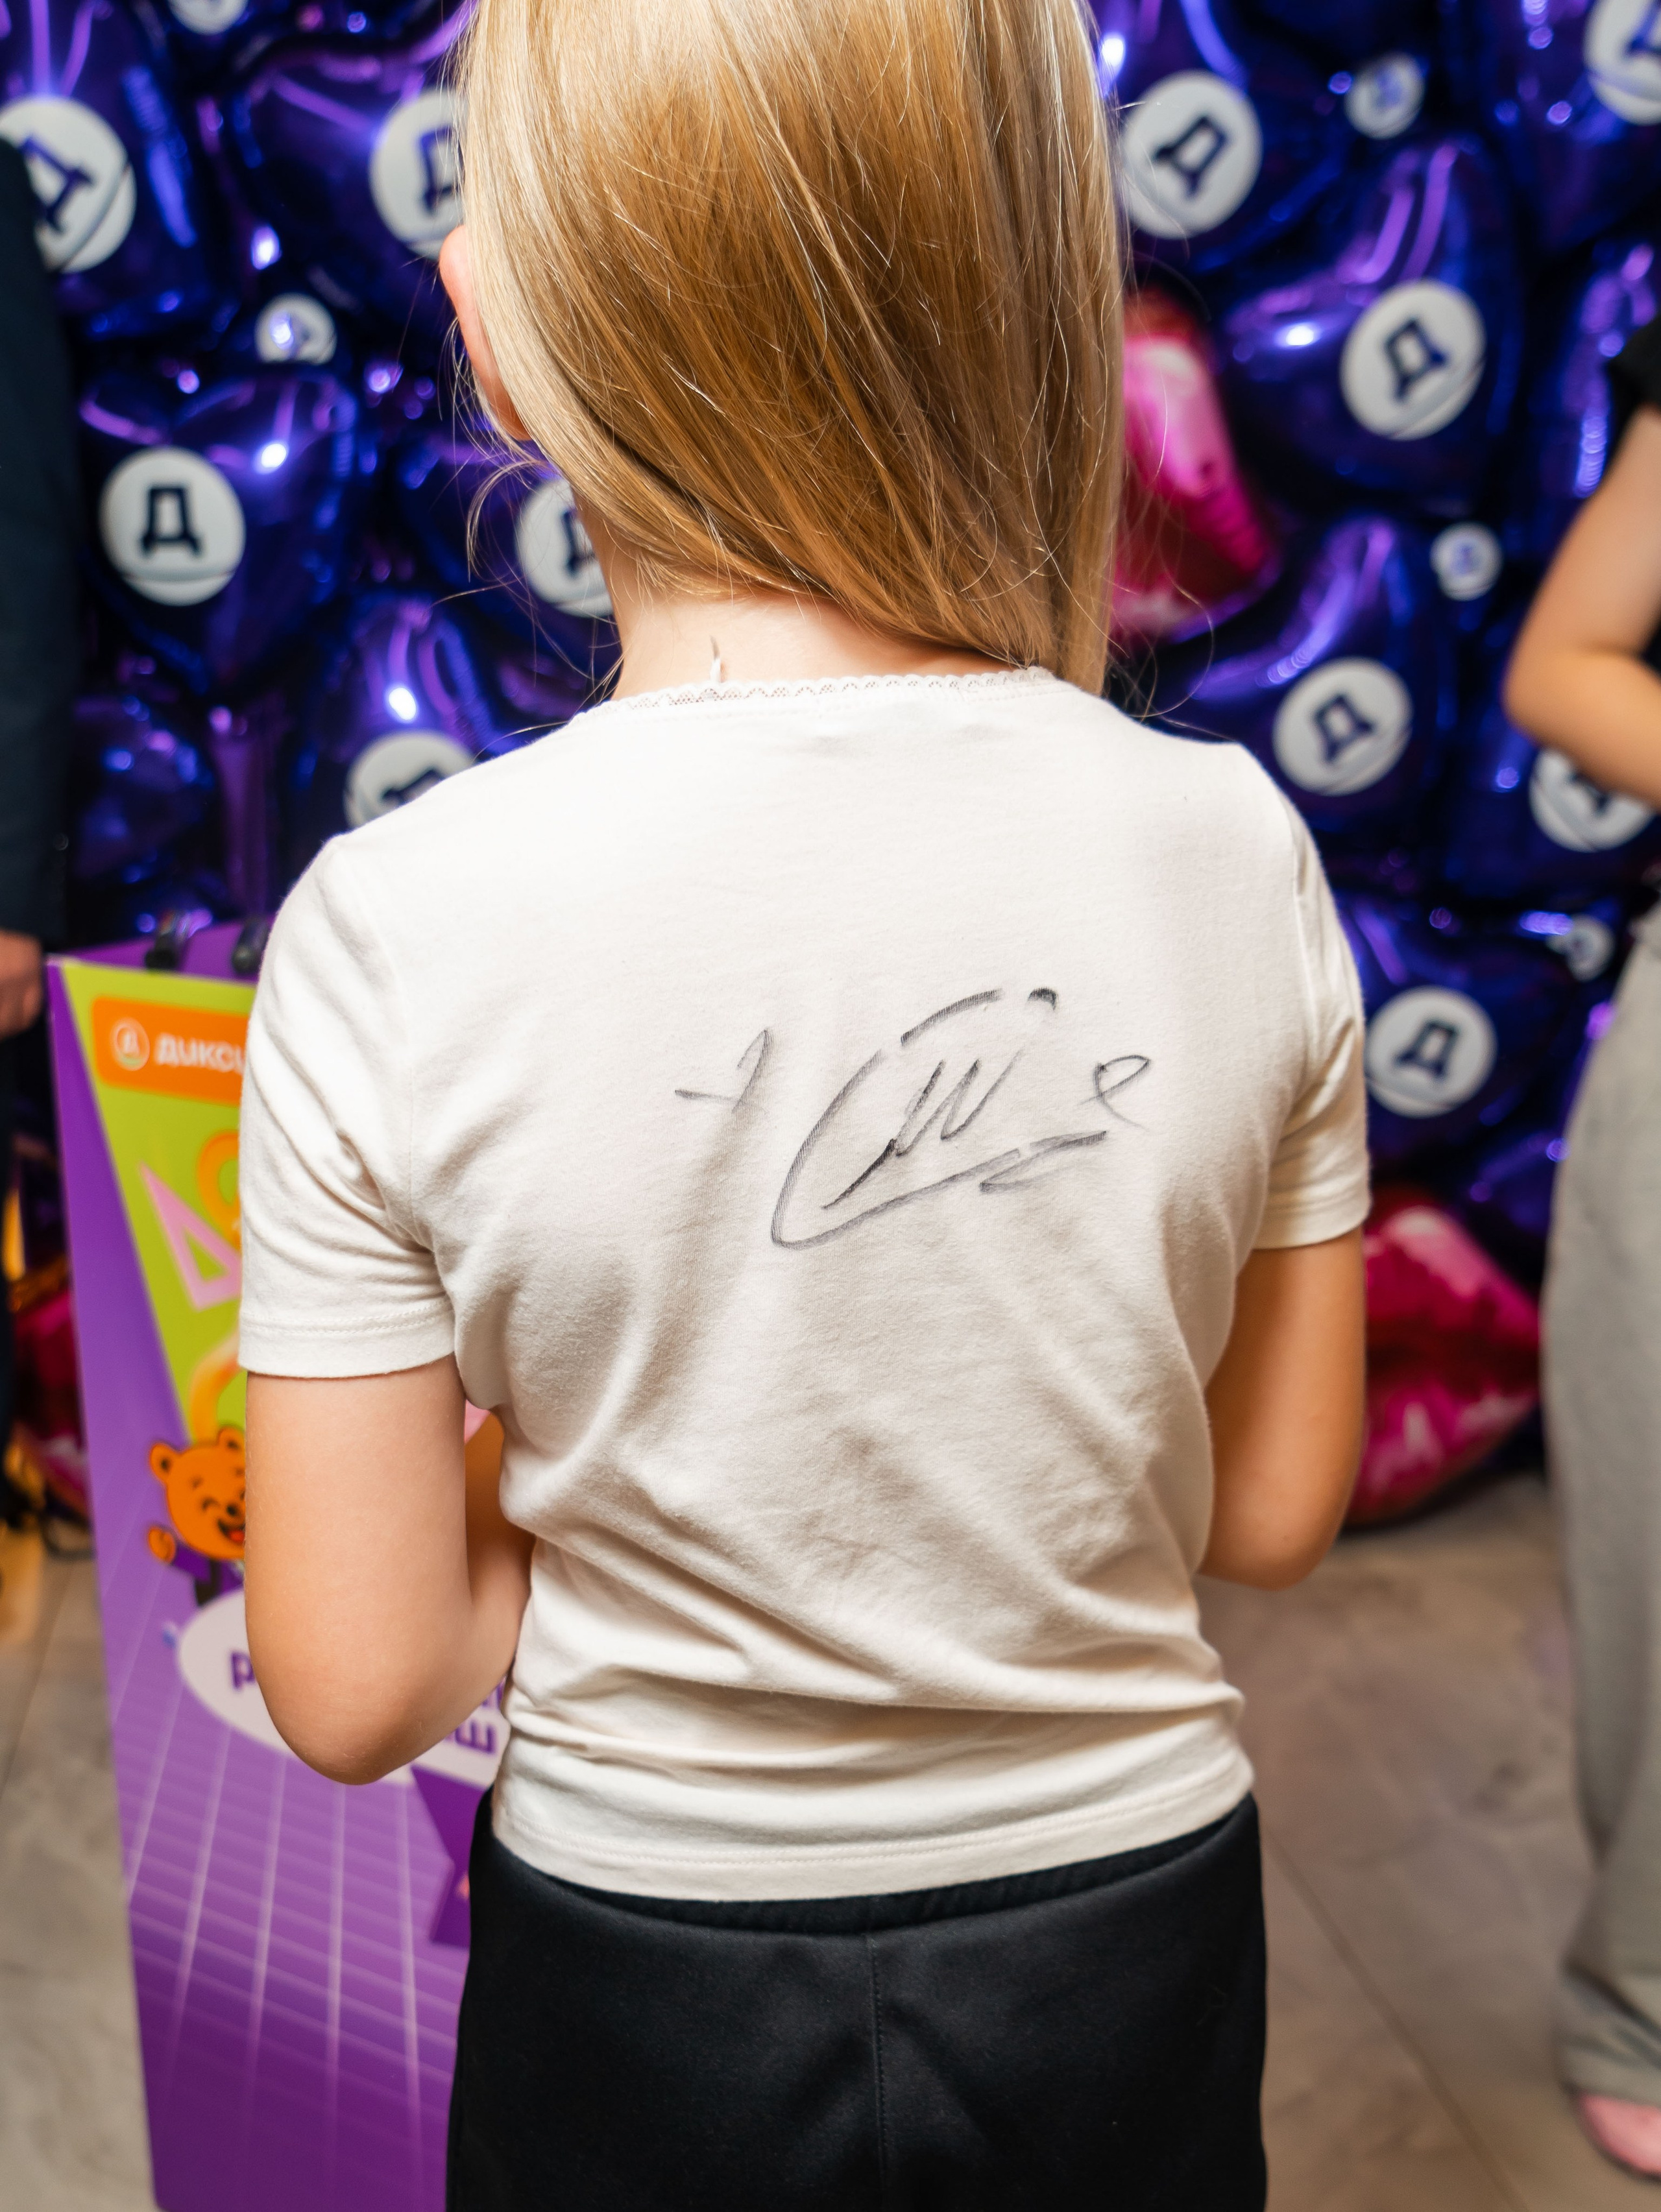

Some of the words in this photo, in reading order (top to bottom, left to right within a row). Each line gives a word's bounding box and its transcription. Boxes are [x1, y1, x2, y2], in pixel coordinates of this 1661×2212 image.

[1150, 114, 1231, 201] Д
[1382, 317, 1452, 405] Д
[137, 483, 202, 558] Д
[1311, 692, 1379, 768] Д
[1391, 1019, 1461, 1084] Д
